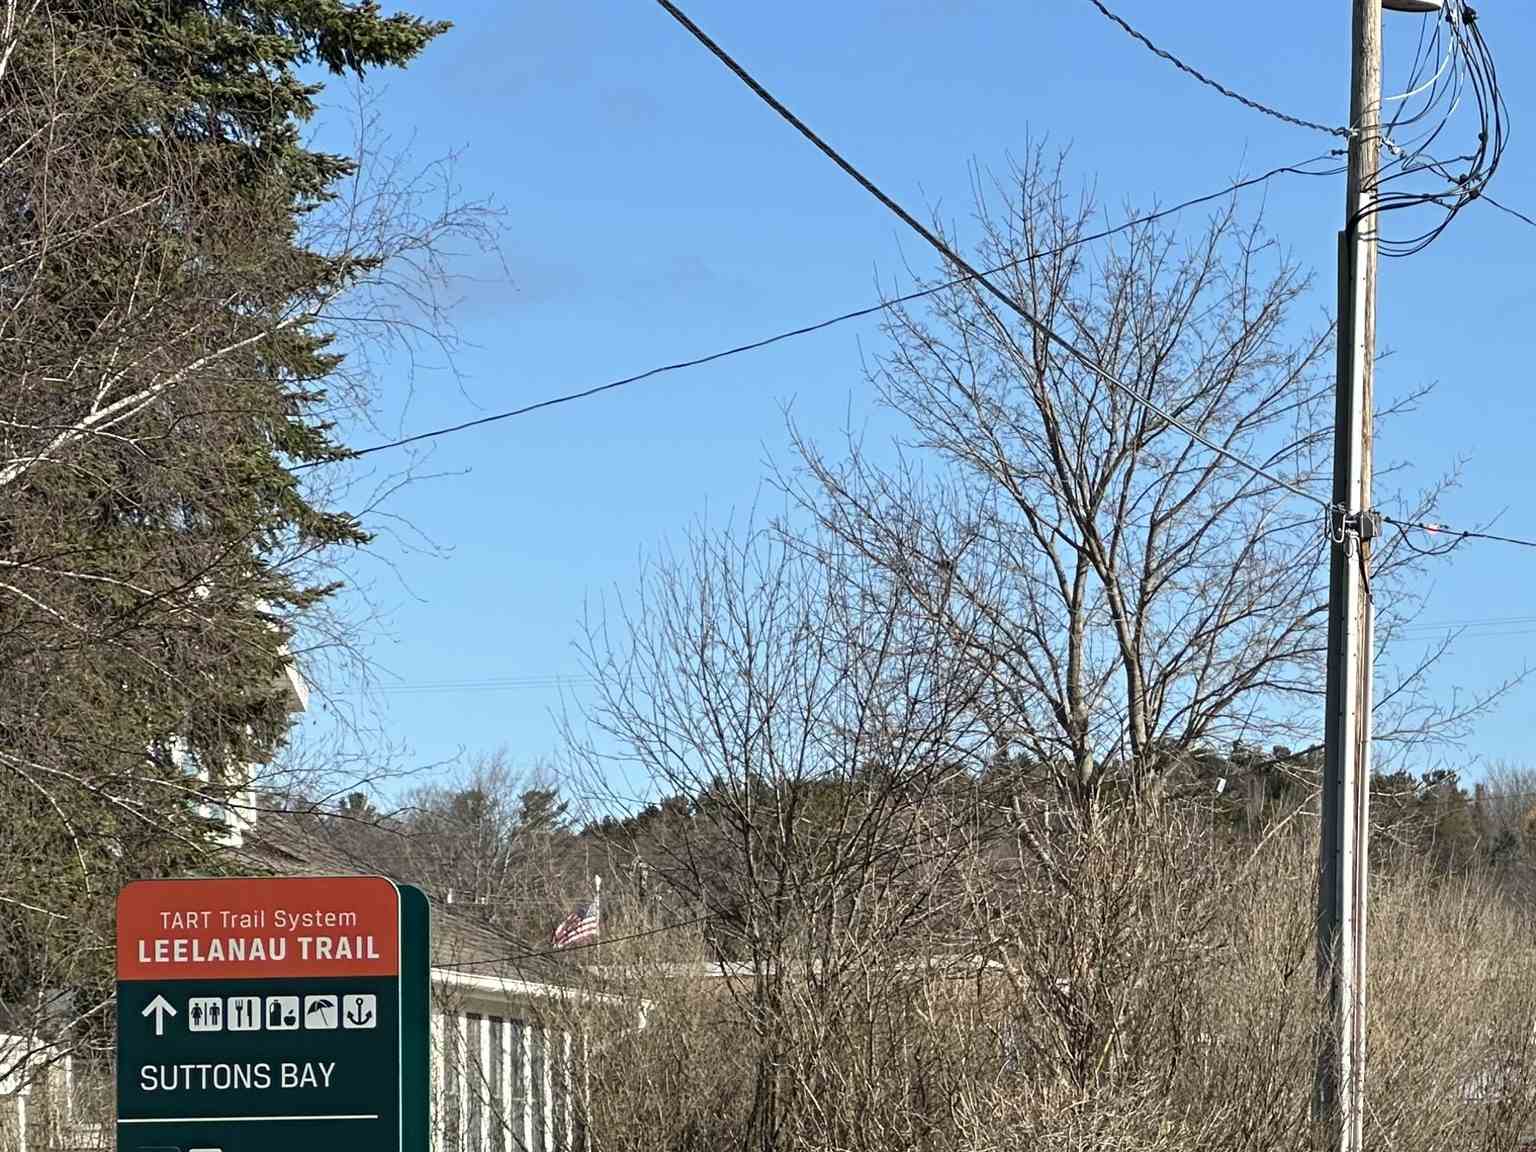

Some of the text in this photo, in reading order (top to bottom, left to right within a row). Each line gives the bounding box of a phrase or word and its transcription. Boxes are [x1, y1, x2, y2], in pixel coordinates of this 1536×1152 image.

[160, 909, 357, 932] TART Trail System
[138, 936, 380, 962] LEELANAU TRAIL
[140, 1062, 336, 1091] SUTTONS BAY
